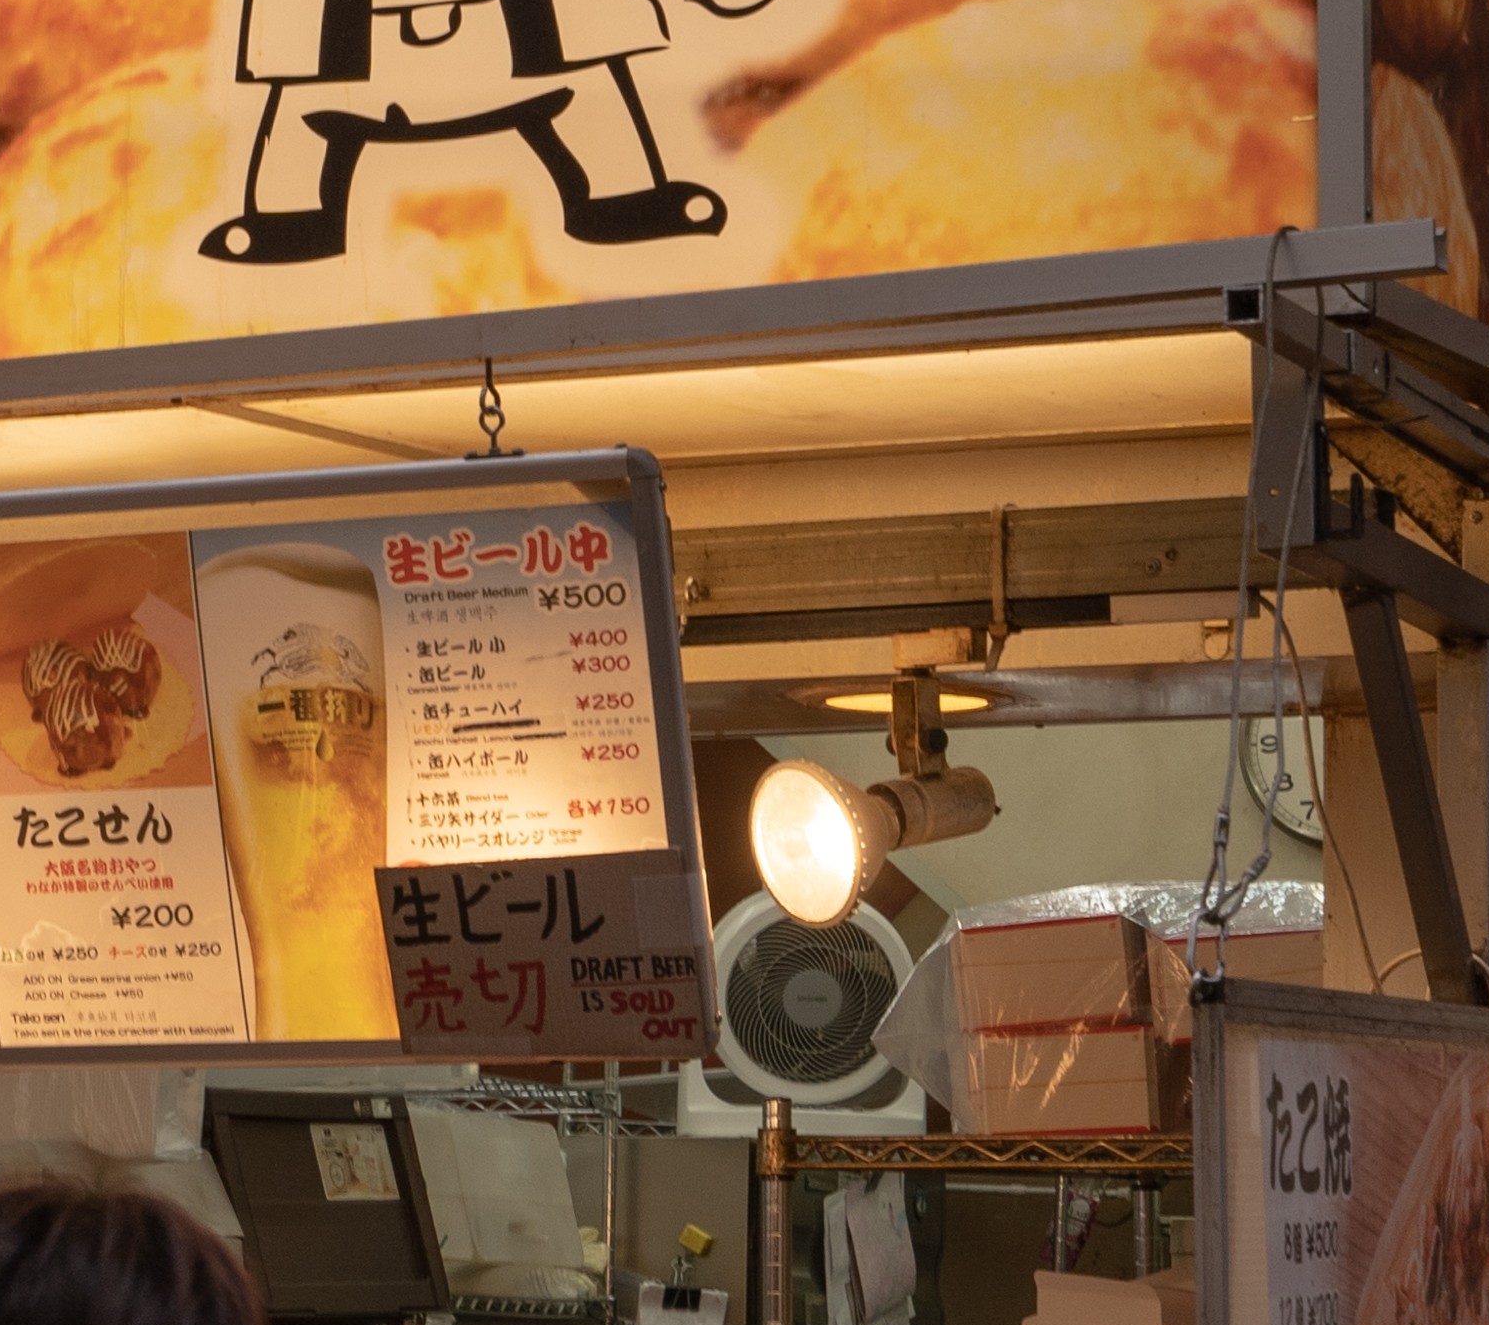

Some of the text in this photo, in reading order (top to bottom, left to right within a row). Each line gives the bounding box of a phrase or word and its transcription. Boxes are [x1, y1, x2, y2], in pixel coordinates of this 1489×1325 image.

[386, 526, 609, 585] 生ビール中
[404, 581, 627, 612] Draft Beer Medium ¥500
[415, 638, 484, 658] 生ビール
[569, 628, 628, 649] ¥400
[419, 655, 631, 684] 缶ビール ¥300
[423, 691, 635, 721] 缶チューハイ ¥250
[428, 742, 640, 770] 缶ハイボール ¥250
[13, 802, 173, 849] たこせん
[45, 856, 157, 877] 大阪名物おやつ
[111, 904, 194, 929] ¥200
[392, 868, 605, 947] 生ビール
[52, 946, 98, 961] ¥250
[174, 942, 222, 958] ¥250
[571, 954, 697, 983] DRAFT BEER
[404, 956, 548, 1036] 売切
[581, 990, 676, 1015] IS SOLD
[641, 1017, 698, 1040] OUT
[1266, 1072, 1353, 1196] たこ焼
